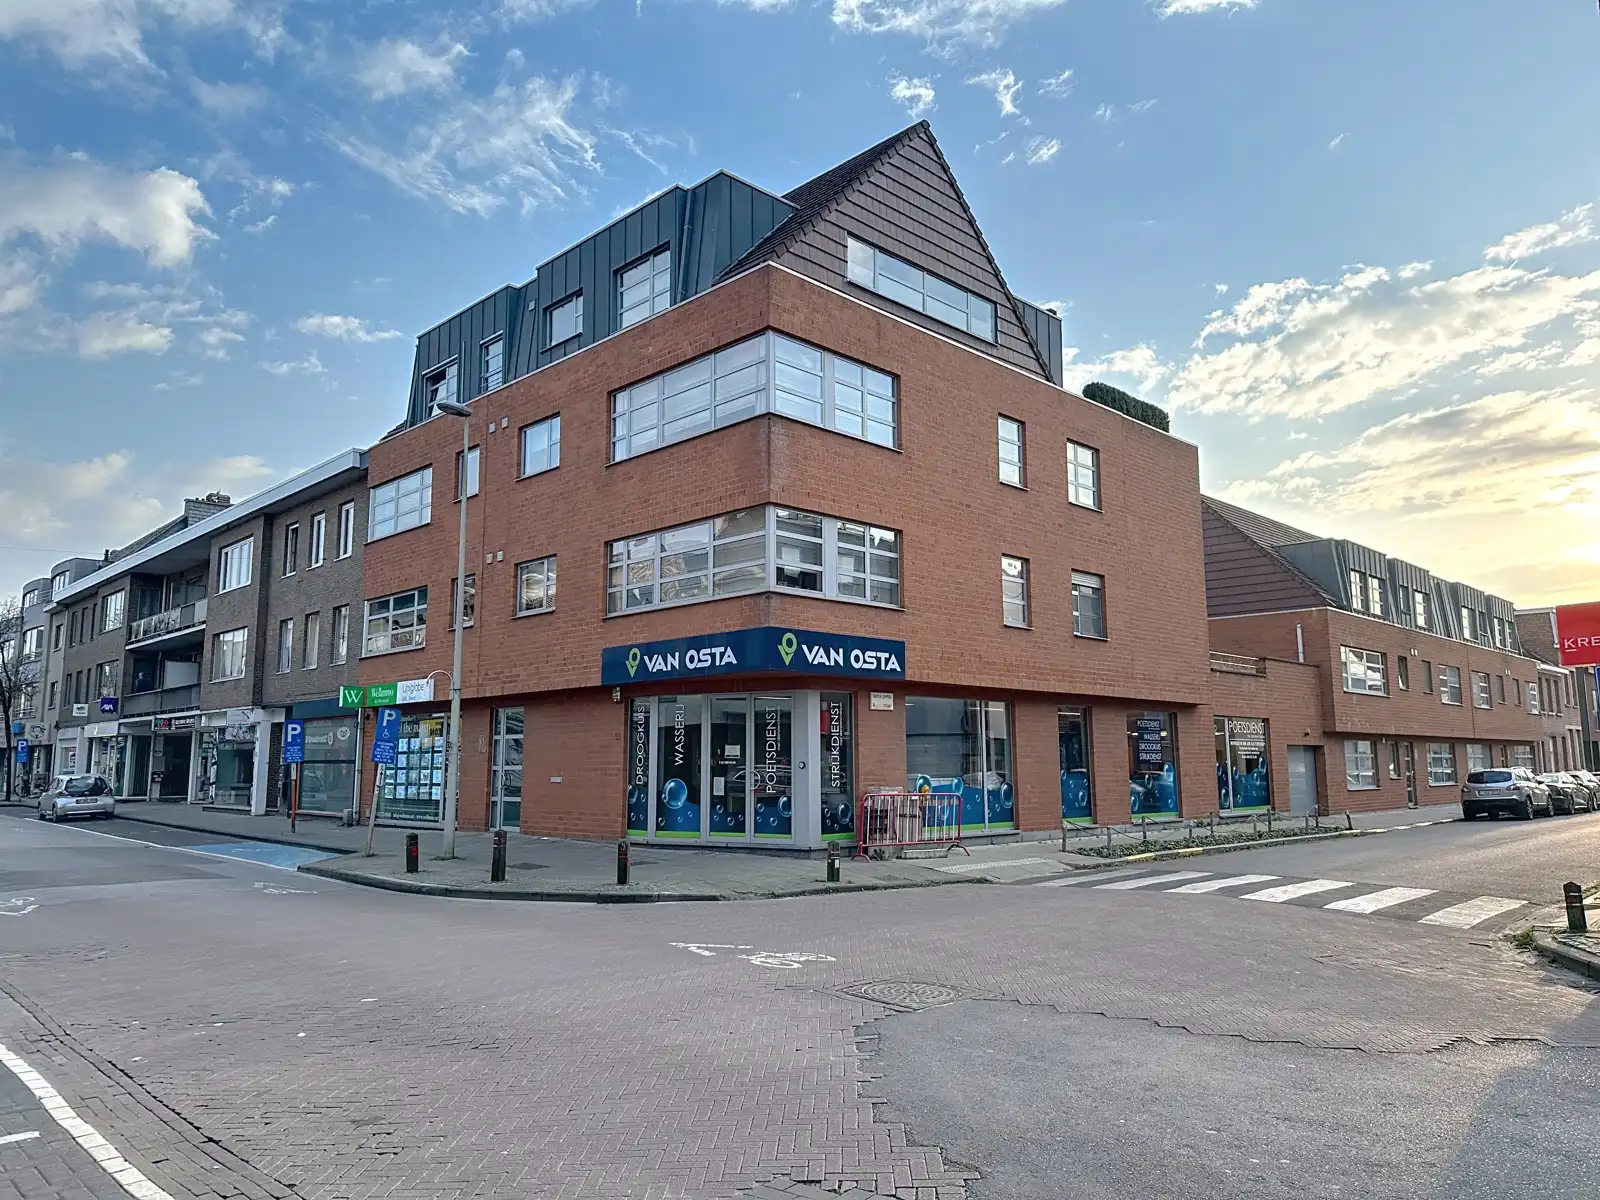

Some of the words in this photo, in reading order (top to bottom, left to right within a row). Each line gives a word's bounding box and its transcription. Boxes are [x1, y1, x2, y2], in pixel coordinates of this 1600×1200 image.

[1564, 636, 1600, 648] KRE
[643, 651, 679, 672] VAN
[685, 646, 737, 669] OSTA
[801, 644, 844, 667] VAN
[850, 649, 901, 672] OSTA
[344, 690, 363, 703] W
[382, 709, 397, 727] P
[1228, 720, 1265, 734] POETSDIENST
[287, 724, 301, 742] P
[674, 704, 685, 766] WASSERIJ
[830, 701, 840, 787] STRIJKDIENST
[18, 741, 27, 752] P
[636, 705, 645, 785] DROOGKUIS
[766, 706, 777, 793] POETSDIENST
